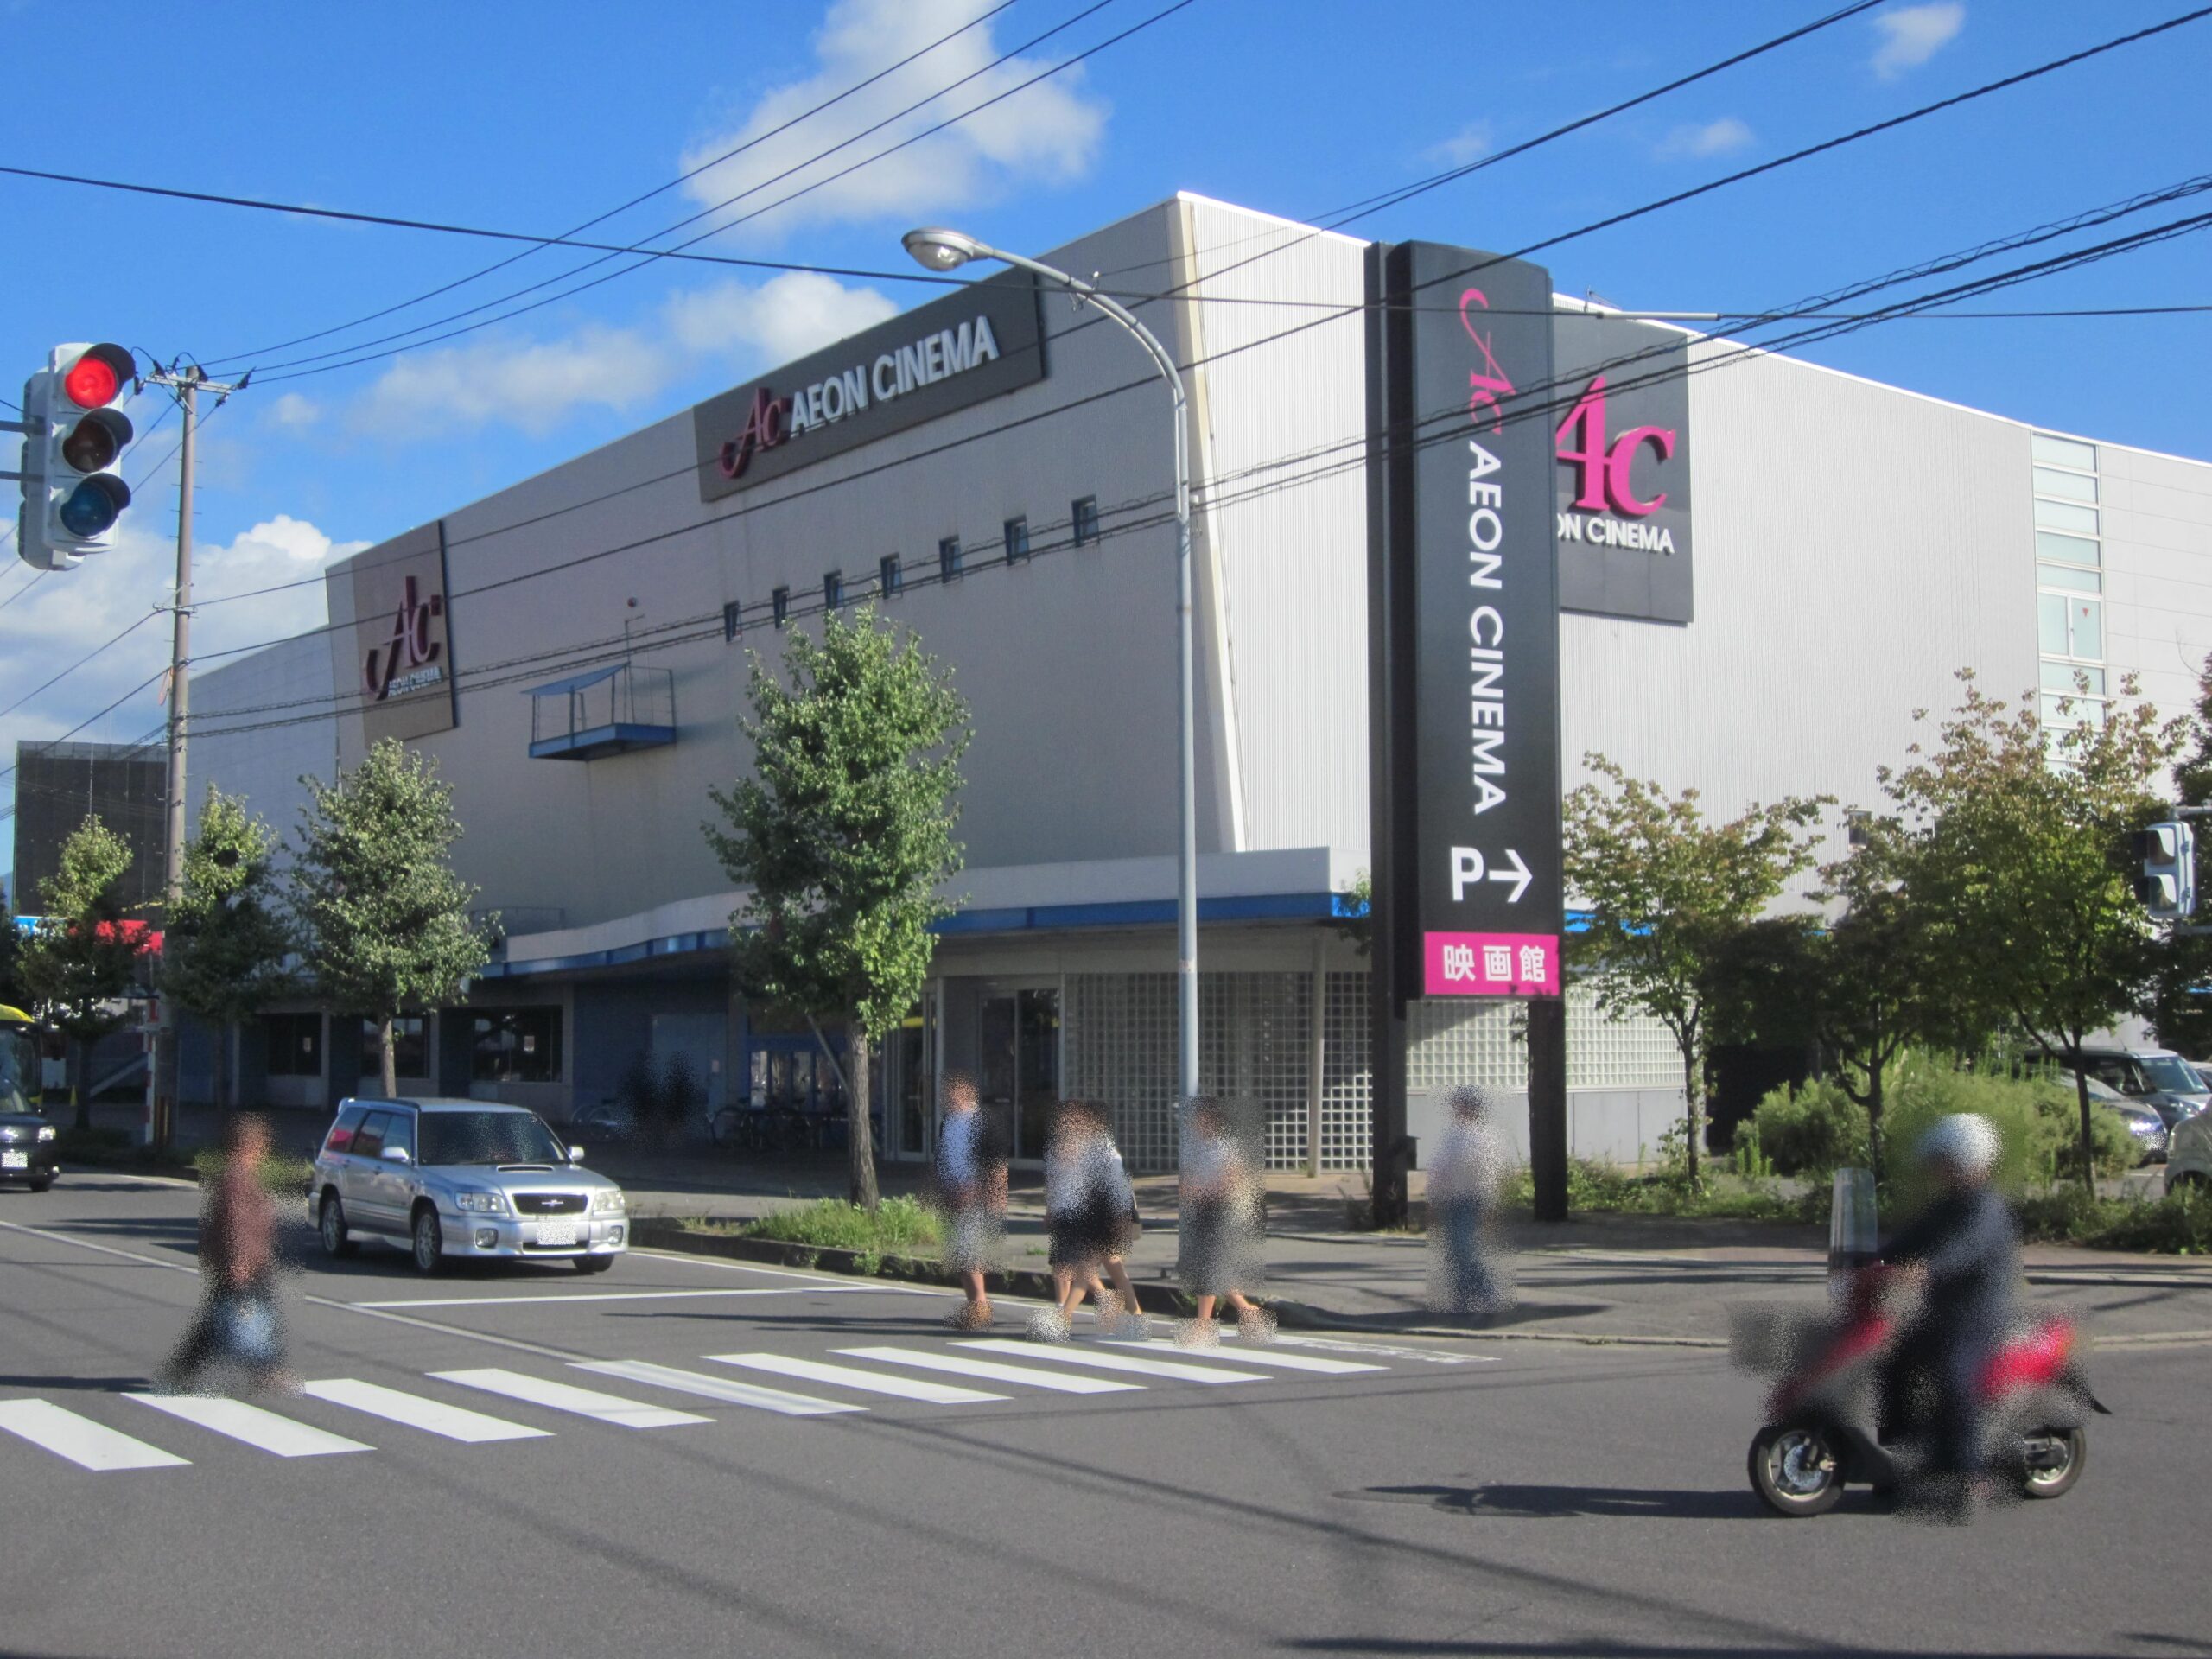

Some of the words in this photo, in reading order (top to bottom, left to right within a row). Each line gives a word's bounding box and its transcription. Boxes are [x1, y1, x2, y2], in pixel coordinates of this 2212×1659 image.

[790, 365, 869, 439] AEON
[873, 315, 1000, 402] CINEMA
[1469, 441, 1503, 589] AEON
[1586, 517, 1675, 554] CINEMA
[1470, 605, 1507, 815] CINEMA
[1450, 846, 1484, 902] P
[1442, 944, 1547, 983] 映画館
